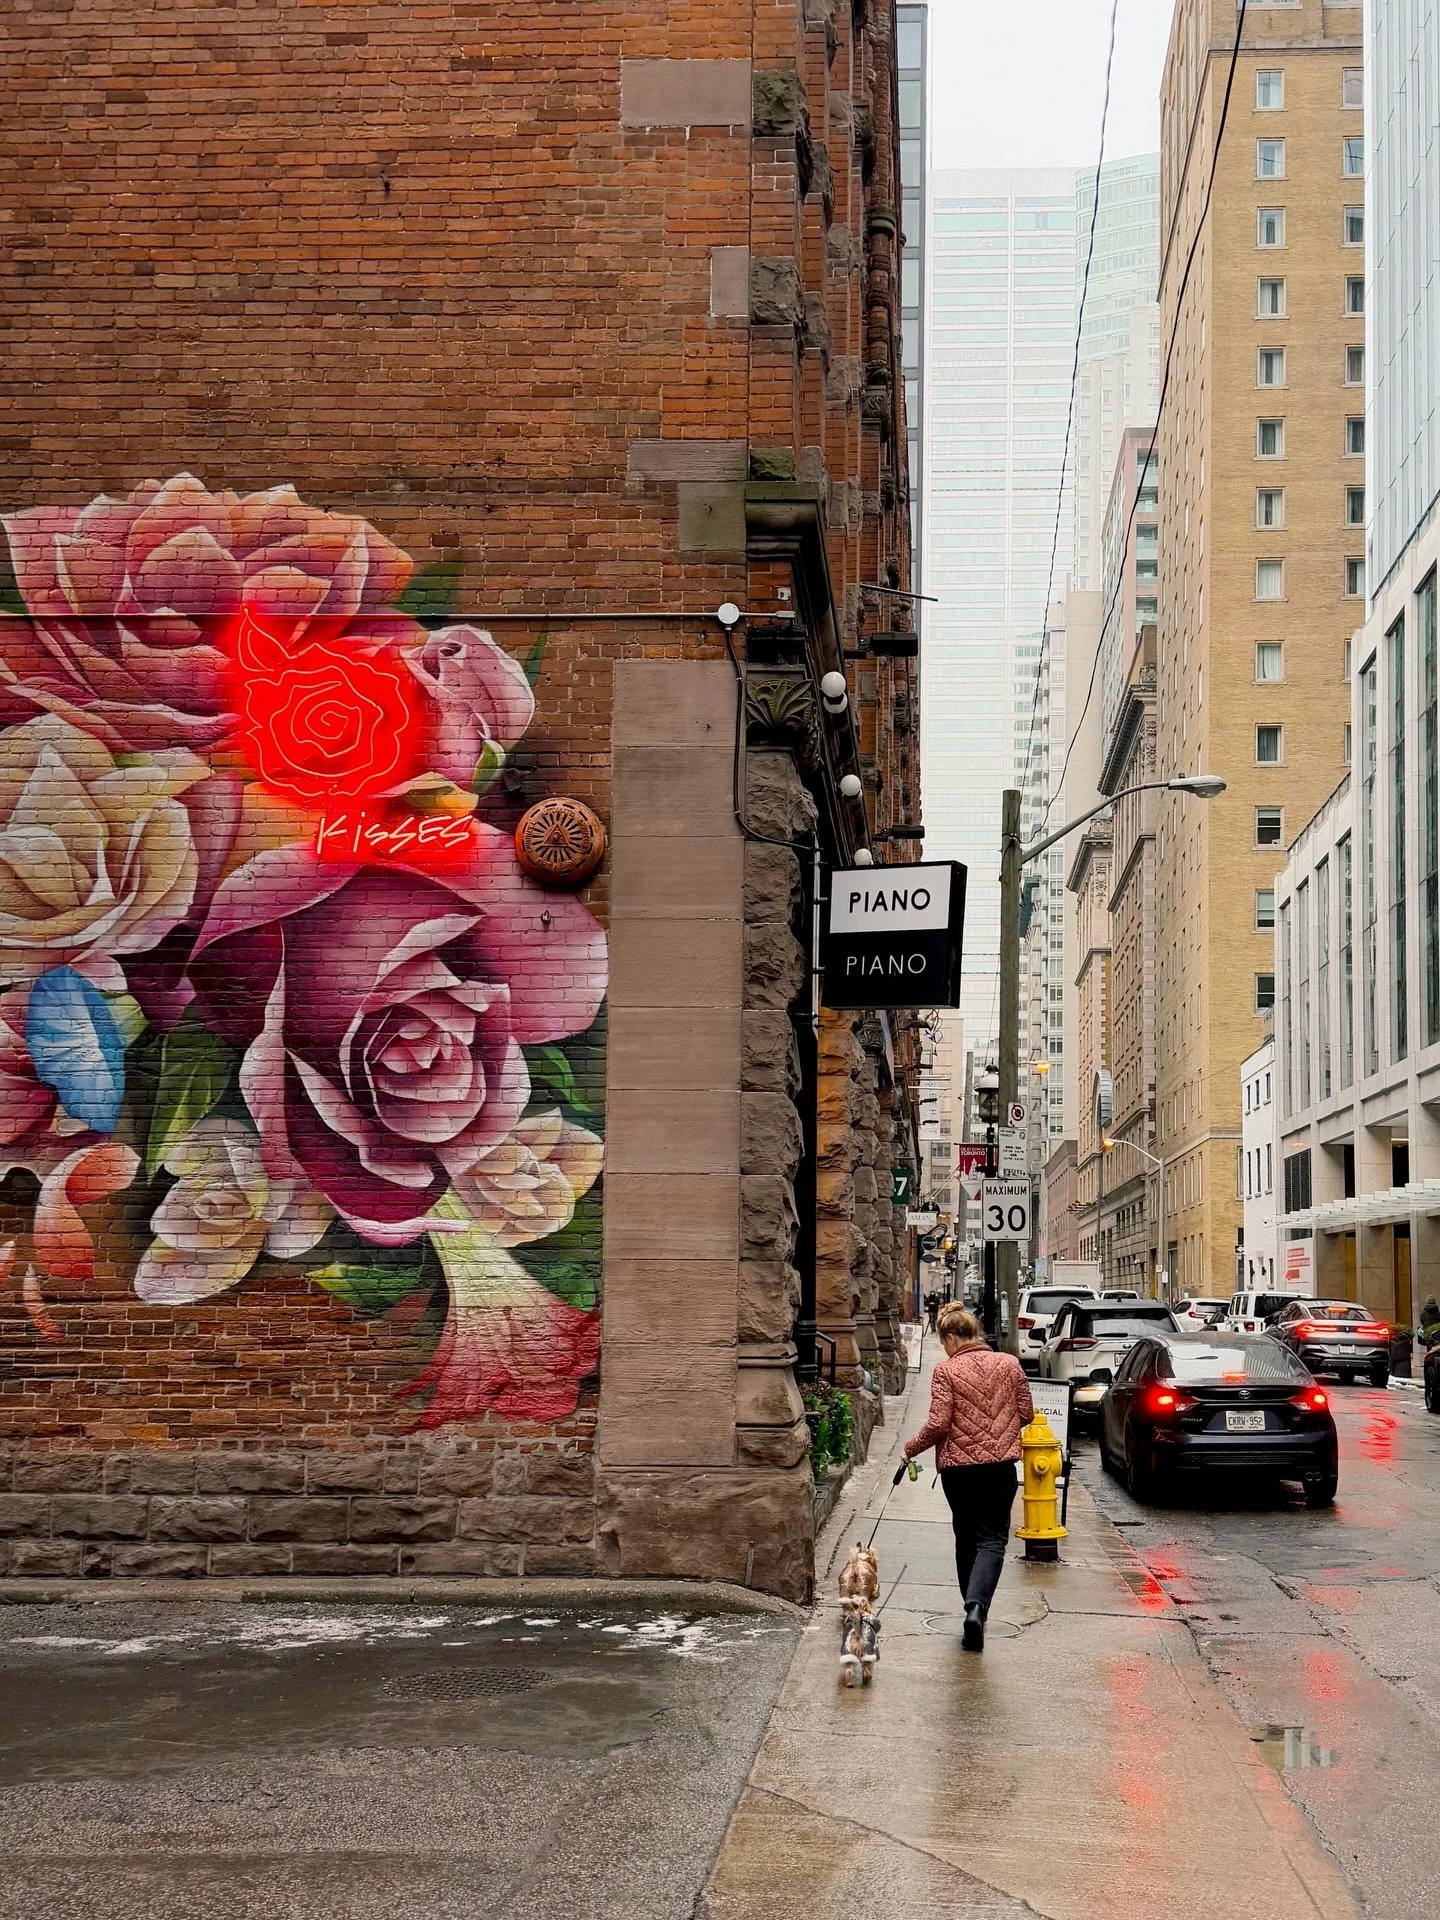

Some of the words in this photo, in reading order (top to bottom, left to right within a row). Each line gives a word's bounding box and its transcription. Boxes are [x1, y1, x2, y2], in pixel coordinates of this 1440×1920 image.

[849, 888, 931, 913] PIANO
[846, 953, 927, 976] PIANO
[894, 1176, 908, 1197] 7
[985, 1185, 1027, 1195] MAXIMUM
[987, 1204, 1026, 1232] 30
